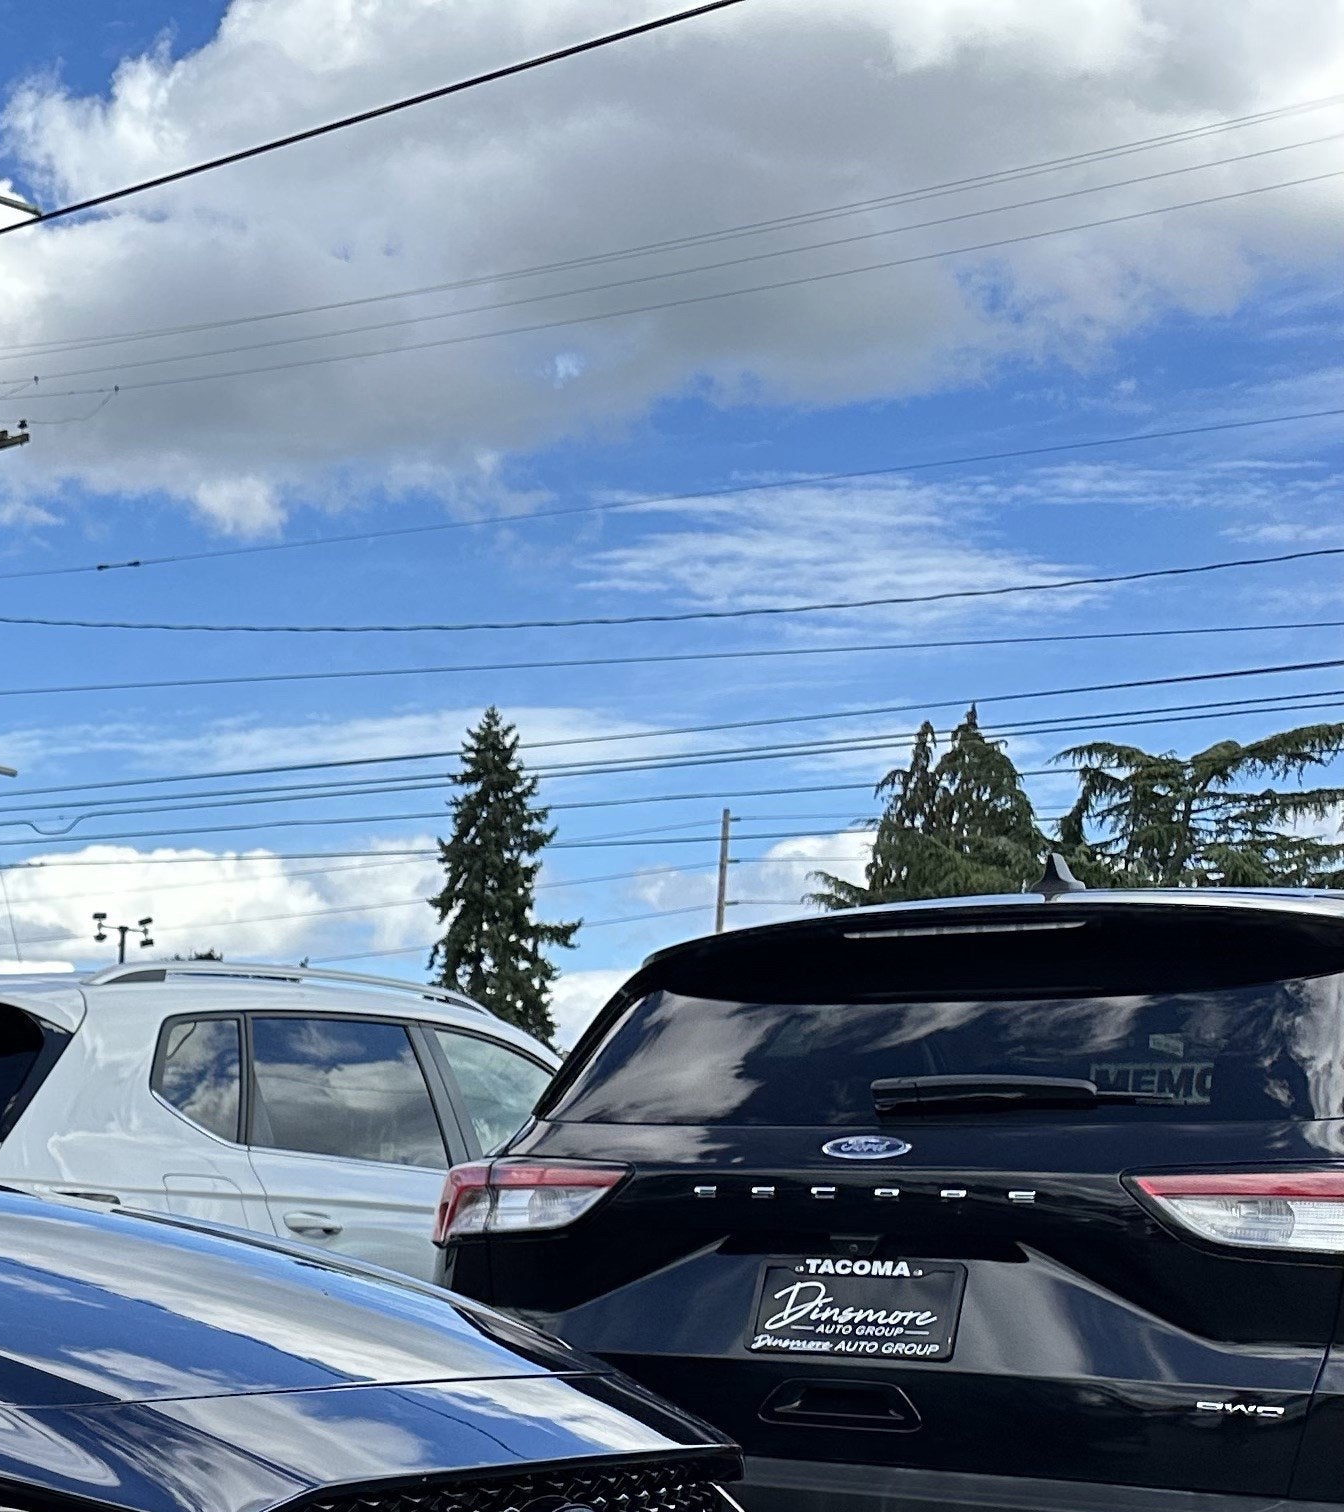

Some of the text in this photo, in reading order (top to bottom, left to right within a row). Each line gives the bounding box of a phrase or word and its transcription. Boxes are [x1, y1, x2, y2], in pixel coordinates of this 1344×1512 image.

[806, 1259, 910, 1277] TACOMA
[765, 1282, 937, 1330] Dinsmore
[815, 1324, 904, 1337] AUTO GROUP
[751, 1334, 940, 1355] Dinsmore AUTO GROUP
